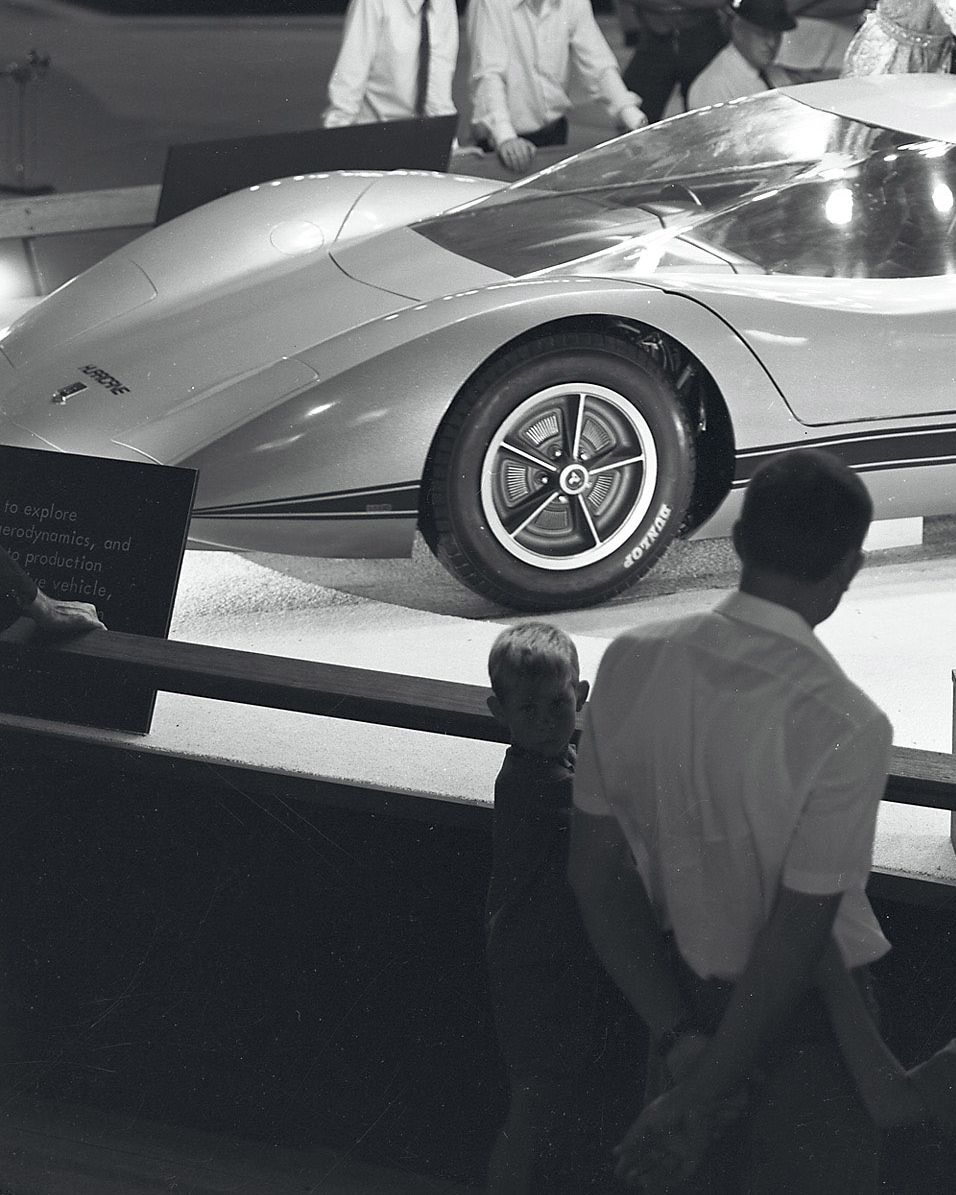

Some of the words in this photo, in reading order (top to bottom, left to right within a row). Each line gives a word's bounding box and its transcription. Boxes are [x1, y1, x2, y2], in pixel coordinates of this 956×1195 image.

[78, 363, 132, 396] HURRICANE
[4, 501, 19, 514] to
[24, 503, 78, 522] explore
[0, 524, 95, 551] erodynamics,
[104, 537, 132, 552] and
[623, 503, 672, 569] DUNLOP
[25, 551, 103, 573] production
[53, 577, 112, 601] vehicle,
